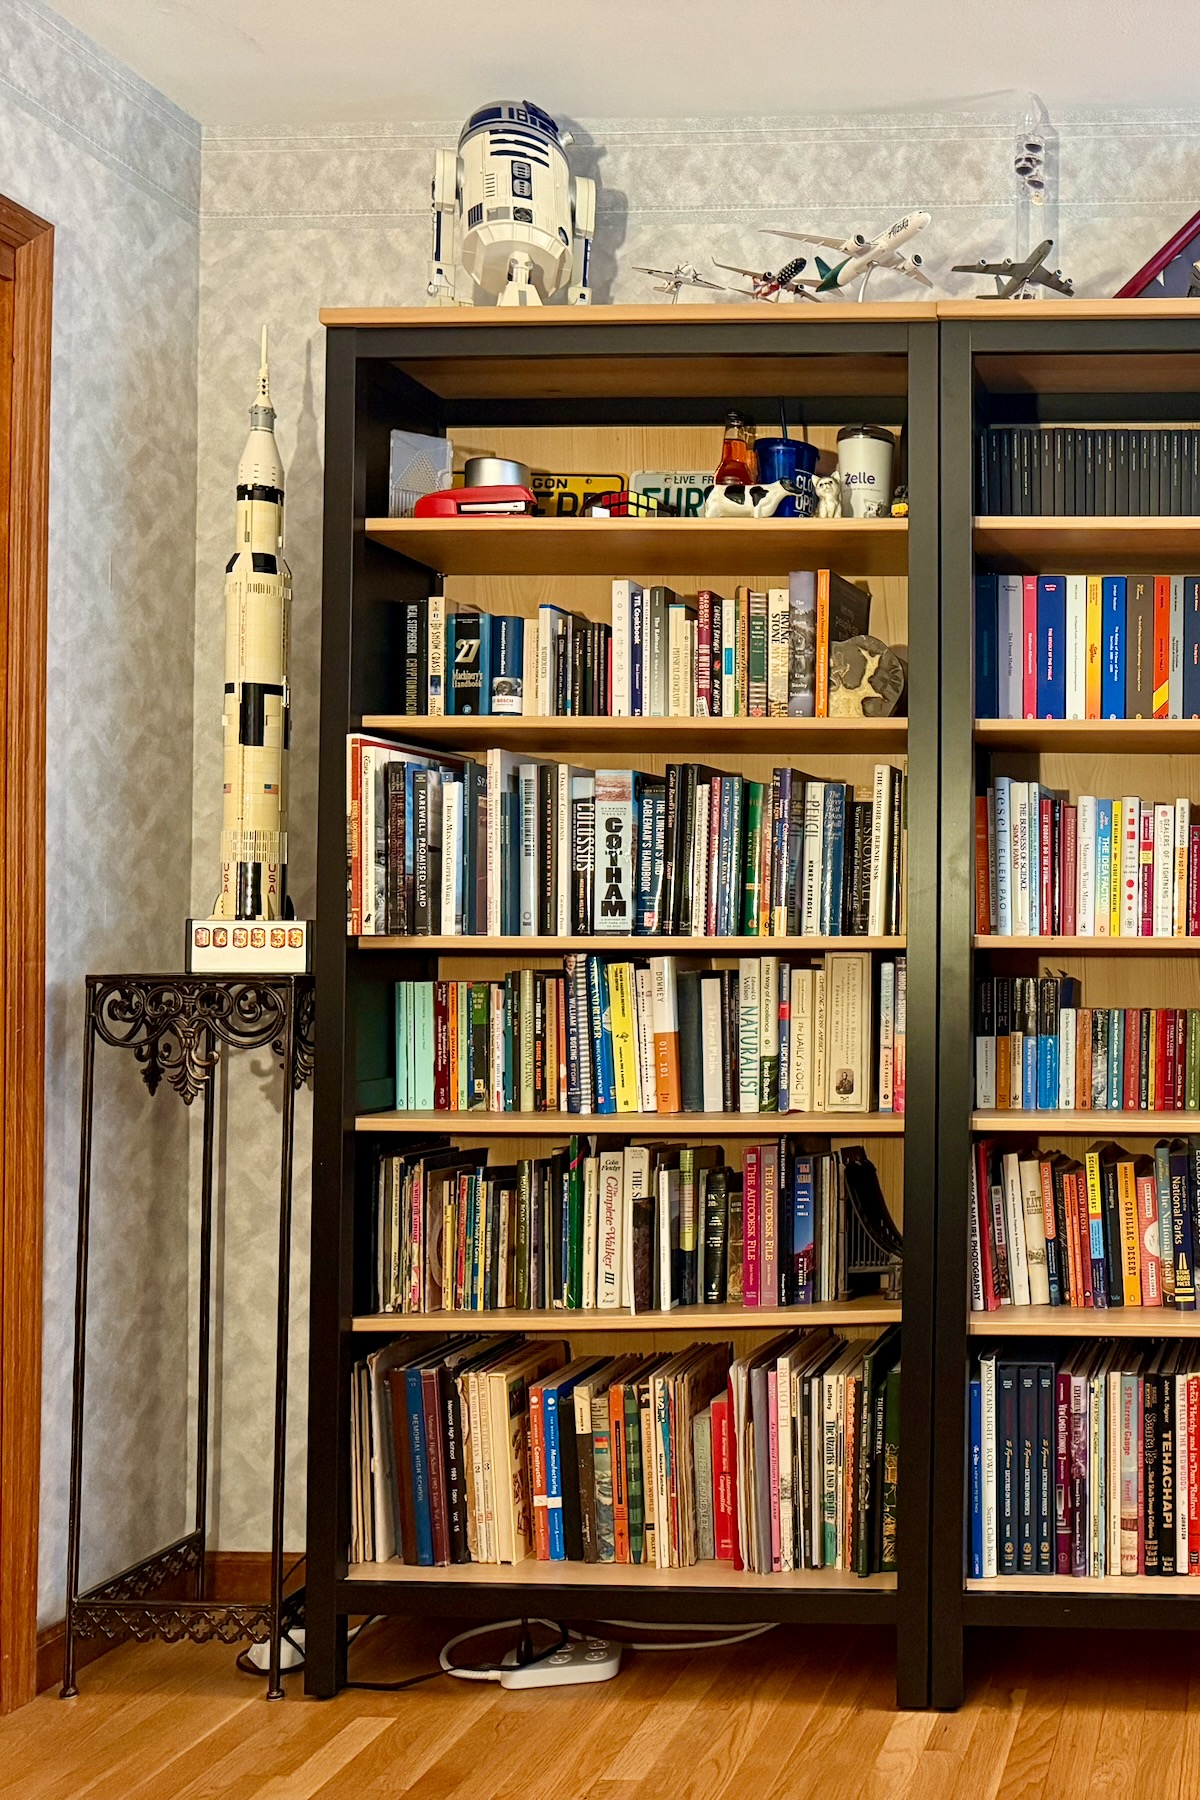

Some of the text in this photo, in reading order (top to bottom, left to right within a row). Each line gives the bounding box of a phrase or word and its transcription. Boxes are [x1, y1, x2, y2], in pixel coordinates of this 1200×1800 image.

[532, 478, 568, 489] GON
[674, 475, 714, 484] LIVE FR
[633, 596, 641, 644] TTL Cookbook
[431, 631, 441, 673] SNOW CRASH
[576, 802, 594, 871] COLOSSUS
[805, 801, 819, 839] PENCIL
[996, 788, 1007, 834] reset
[268, 863, 276, 894] USA
[998, 849, 1006, 909] ELLEN PAO
[1100, 837, 1109, 915] THE IDEA FACTORY
[656, 972, 664, 1002] DOWNEY
[659, 1041, 668, 1077] OIL 101
[740, 1006, 757, 1095] NATURALIST
[796, 1022, 805, 1089] The DAILY STOIC
[764, 1166, 774, 1185] THE
[604, 1177, 615, 1284] Complete Walker III
[1125, 1202, 1136, 1276] CADILLAC DESERT
[985, 1364, 994, 1485] MOUNTAIN LIGHT ROWELL
[412, 1414, 423, 1502] MEMORIAL HIGH SCHOOL
[1162, 1431, 1172, 1528] TEHACHAPI
[986, 1507, 994, 1566] Sierra Club Books
